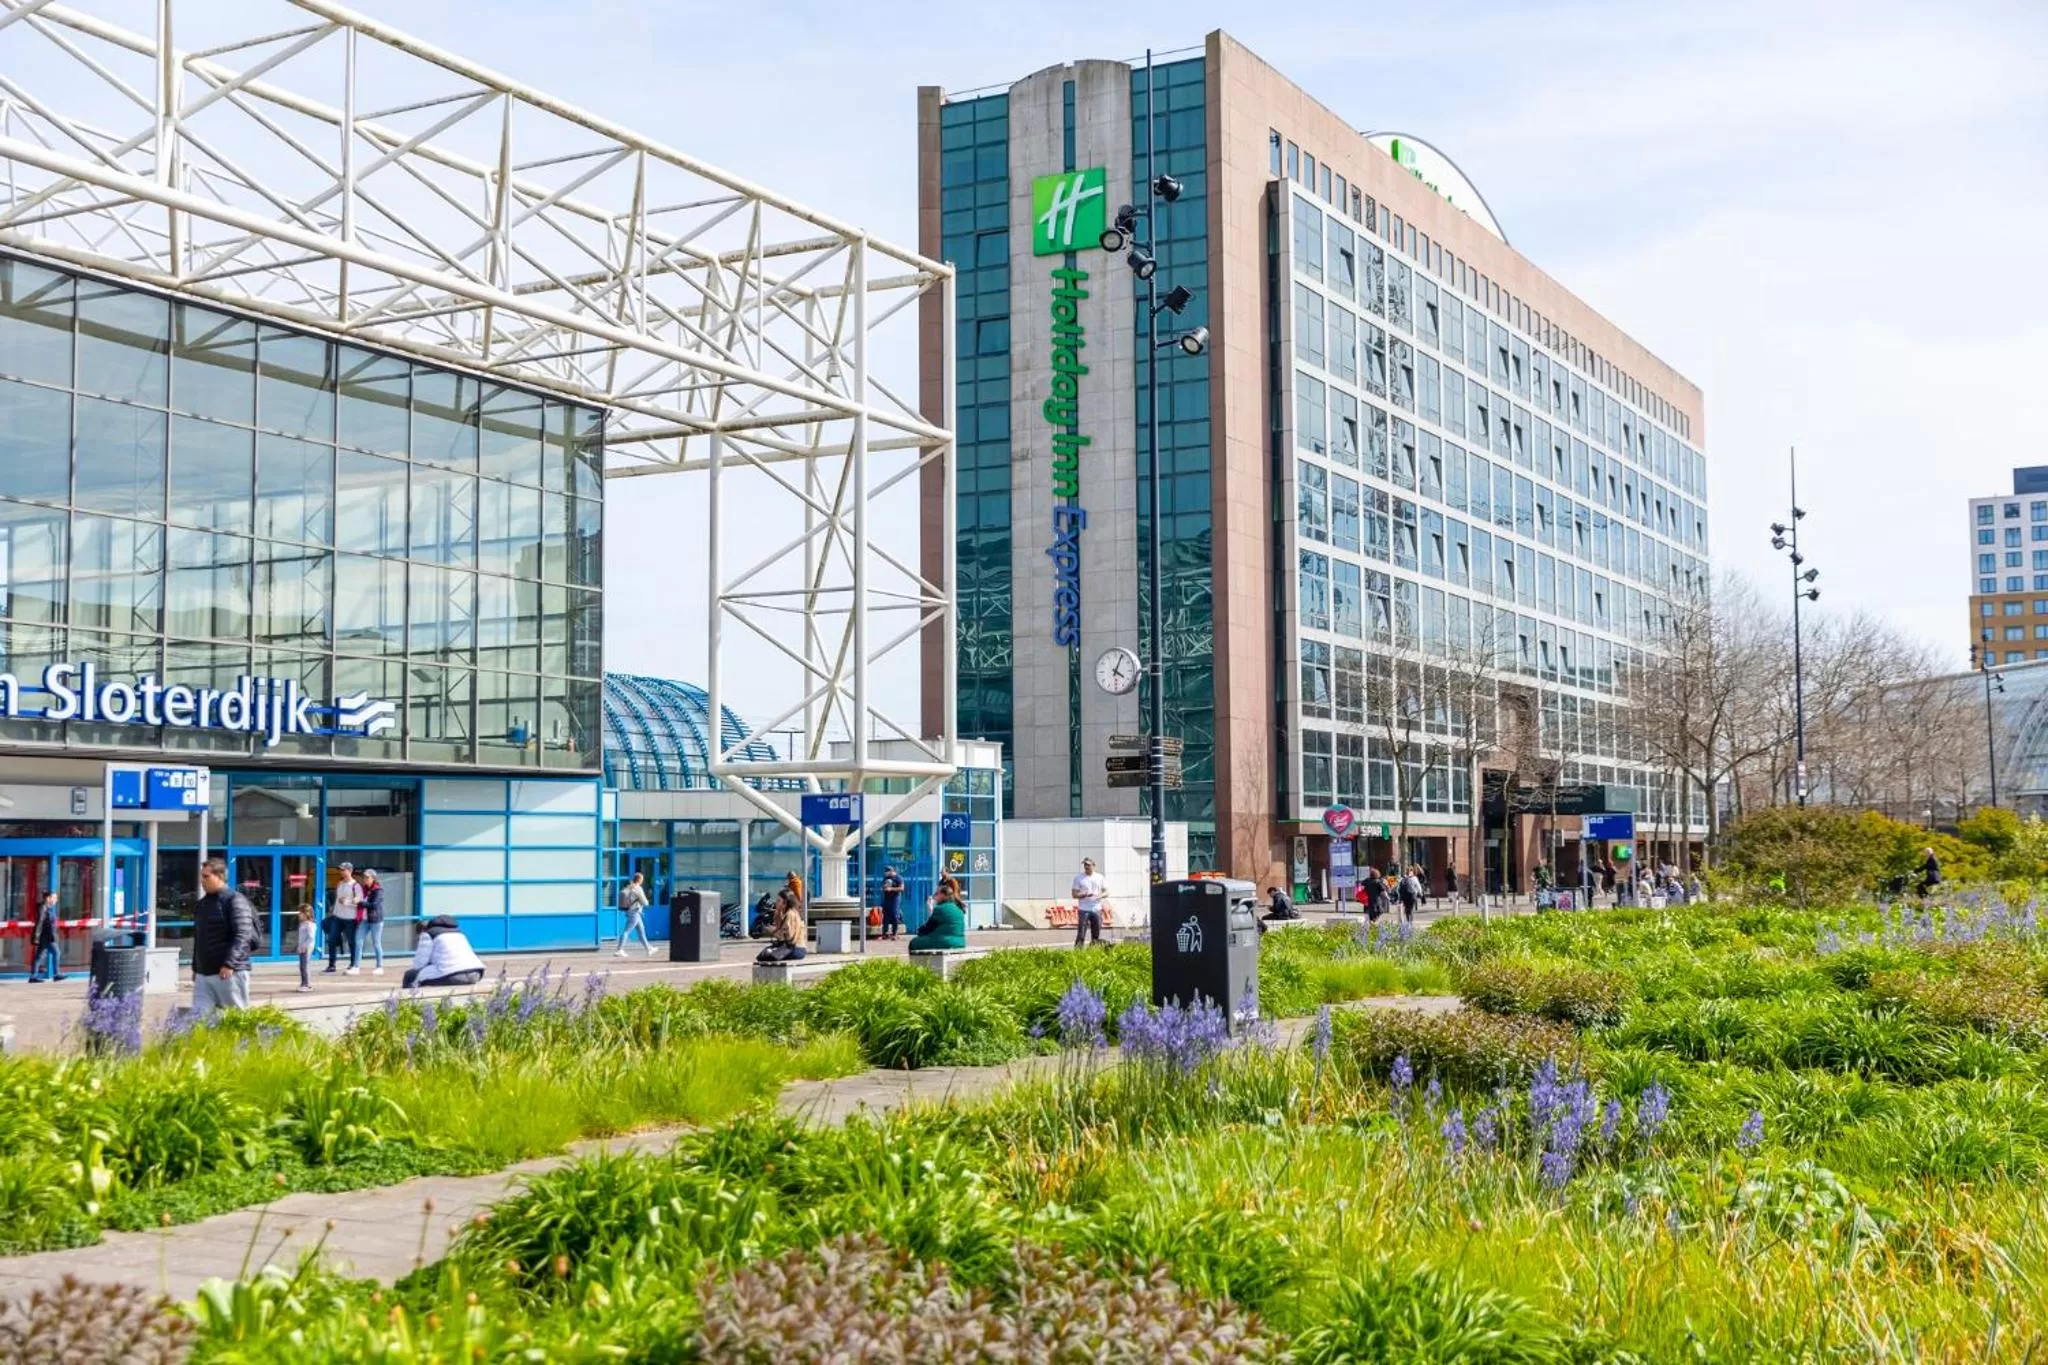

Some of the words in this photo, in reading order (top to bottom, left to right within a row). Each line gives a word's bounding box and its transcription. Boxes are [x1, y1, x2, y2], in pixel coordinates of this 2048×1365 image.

[1042, 267, 1089, 427] Holiday
[1051, 431, 1091, 497] Inn
[1045, 505, 1087, 647] Express
[44, 662, 313, 746] Sloterdijk
[943, 818, 950, 829] P
